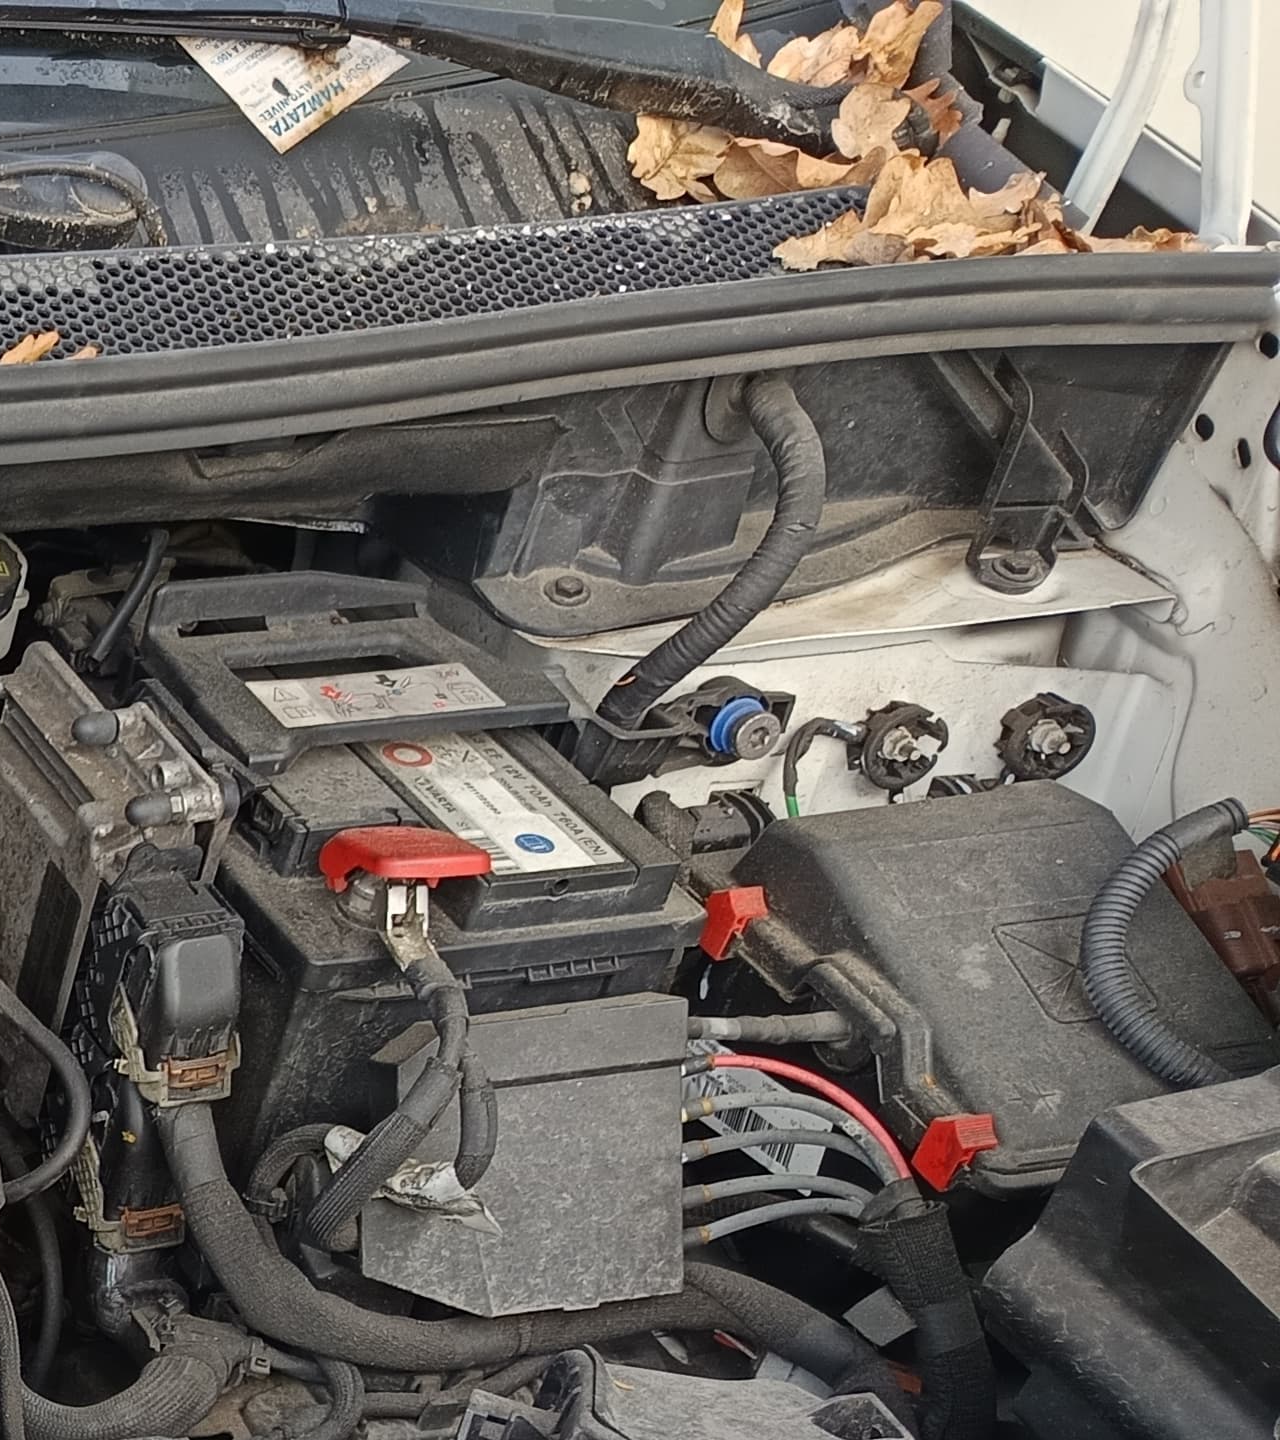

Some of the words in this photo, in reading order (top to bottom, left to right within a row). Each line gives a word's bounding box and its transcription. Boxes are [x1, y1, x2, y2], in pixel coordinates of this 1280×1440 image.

[268, 78, 346, 139] HAMZATA
[422, 786, 459, 812] VARTA
[500, 764, 526, 779] 12V
[521, 785, 556, 807] 70Ah
[551, 812, 586, 834] 760A
[577, 836, 610, 855] (EN)
